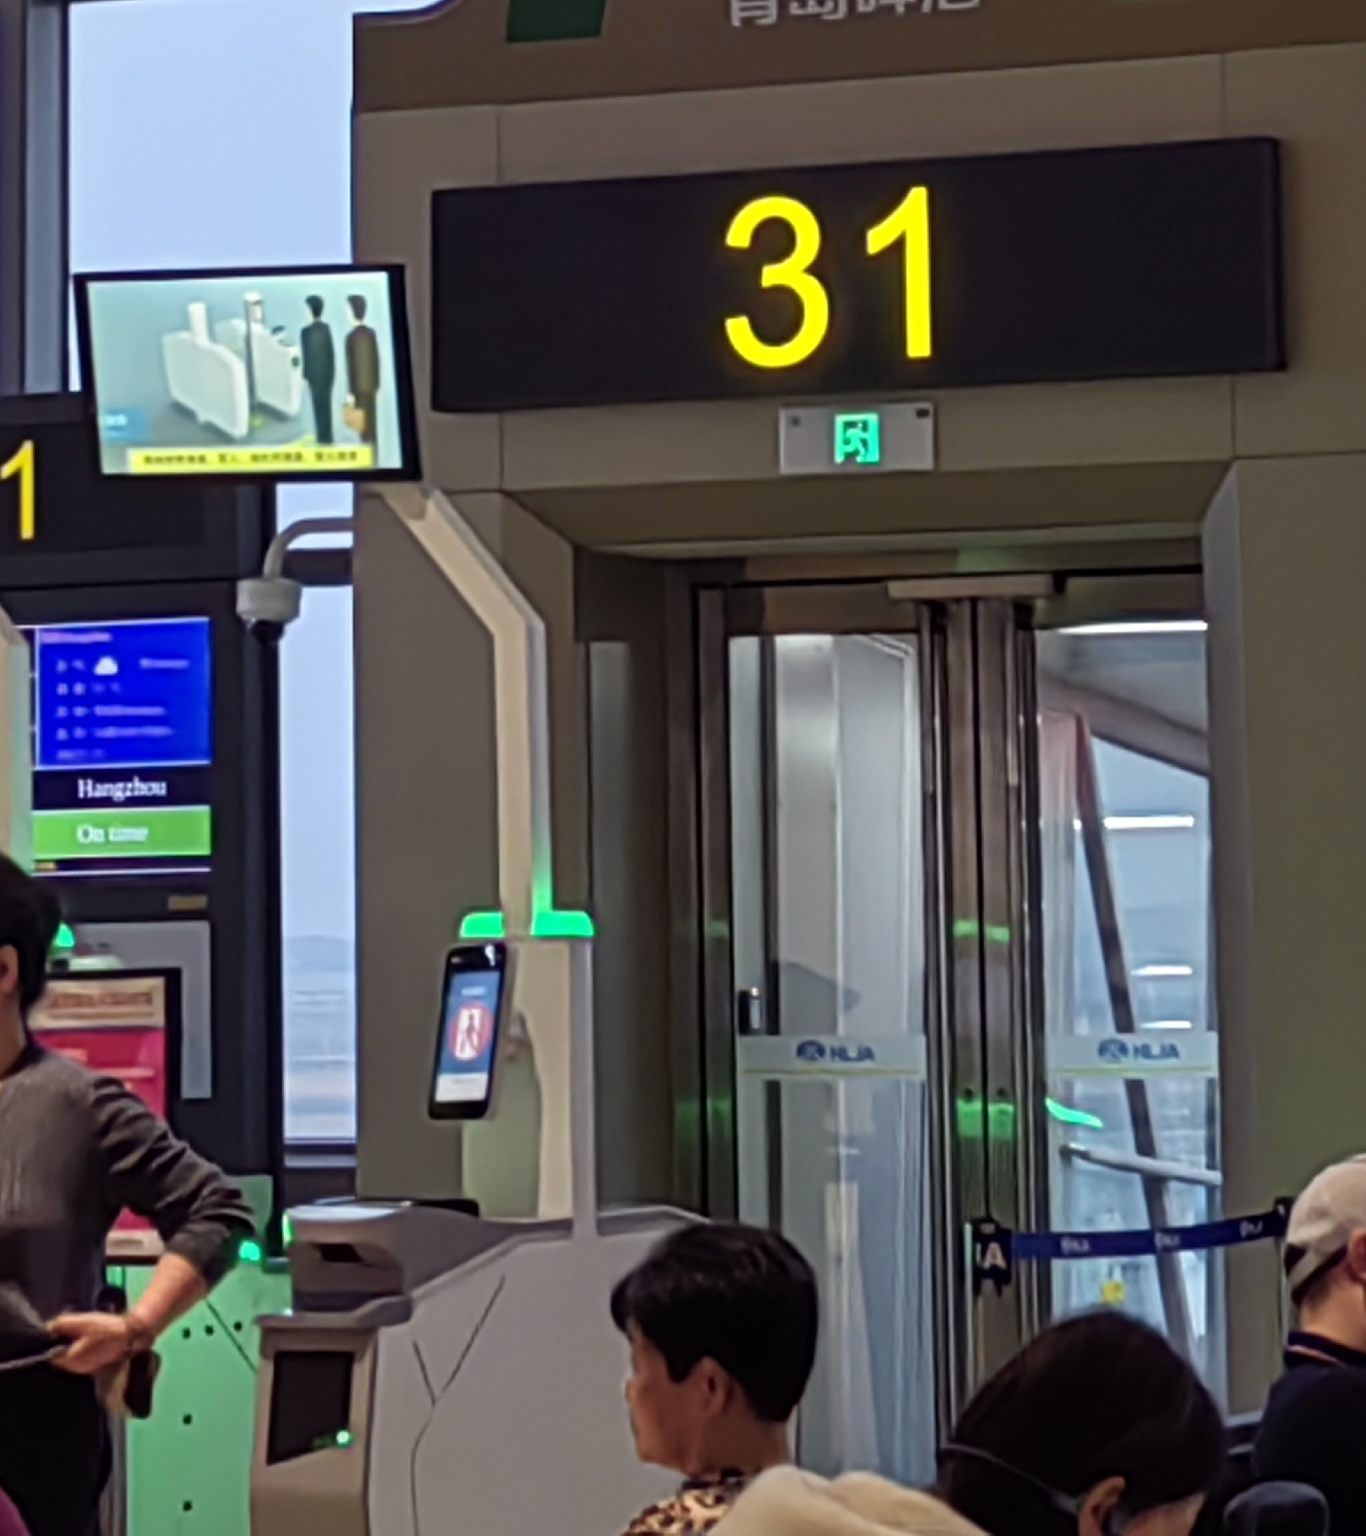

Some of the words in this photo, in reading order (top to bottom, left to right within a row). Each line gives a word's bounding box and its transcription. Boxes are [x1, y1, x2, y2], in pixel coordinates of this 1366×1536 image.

[723, 185, 933, 369] 31
[77, 775, 167, 803] Hangzhou
[76, 823, 106, 844] On
[108, 825, 149, 843] time
